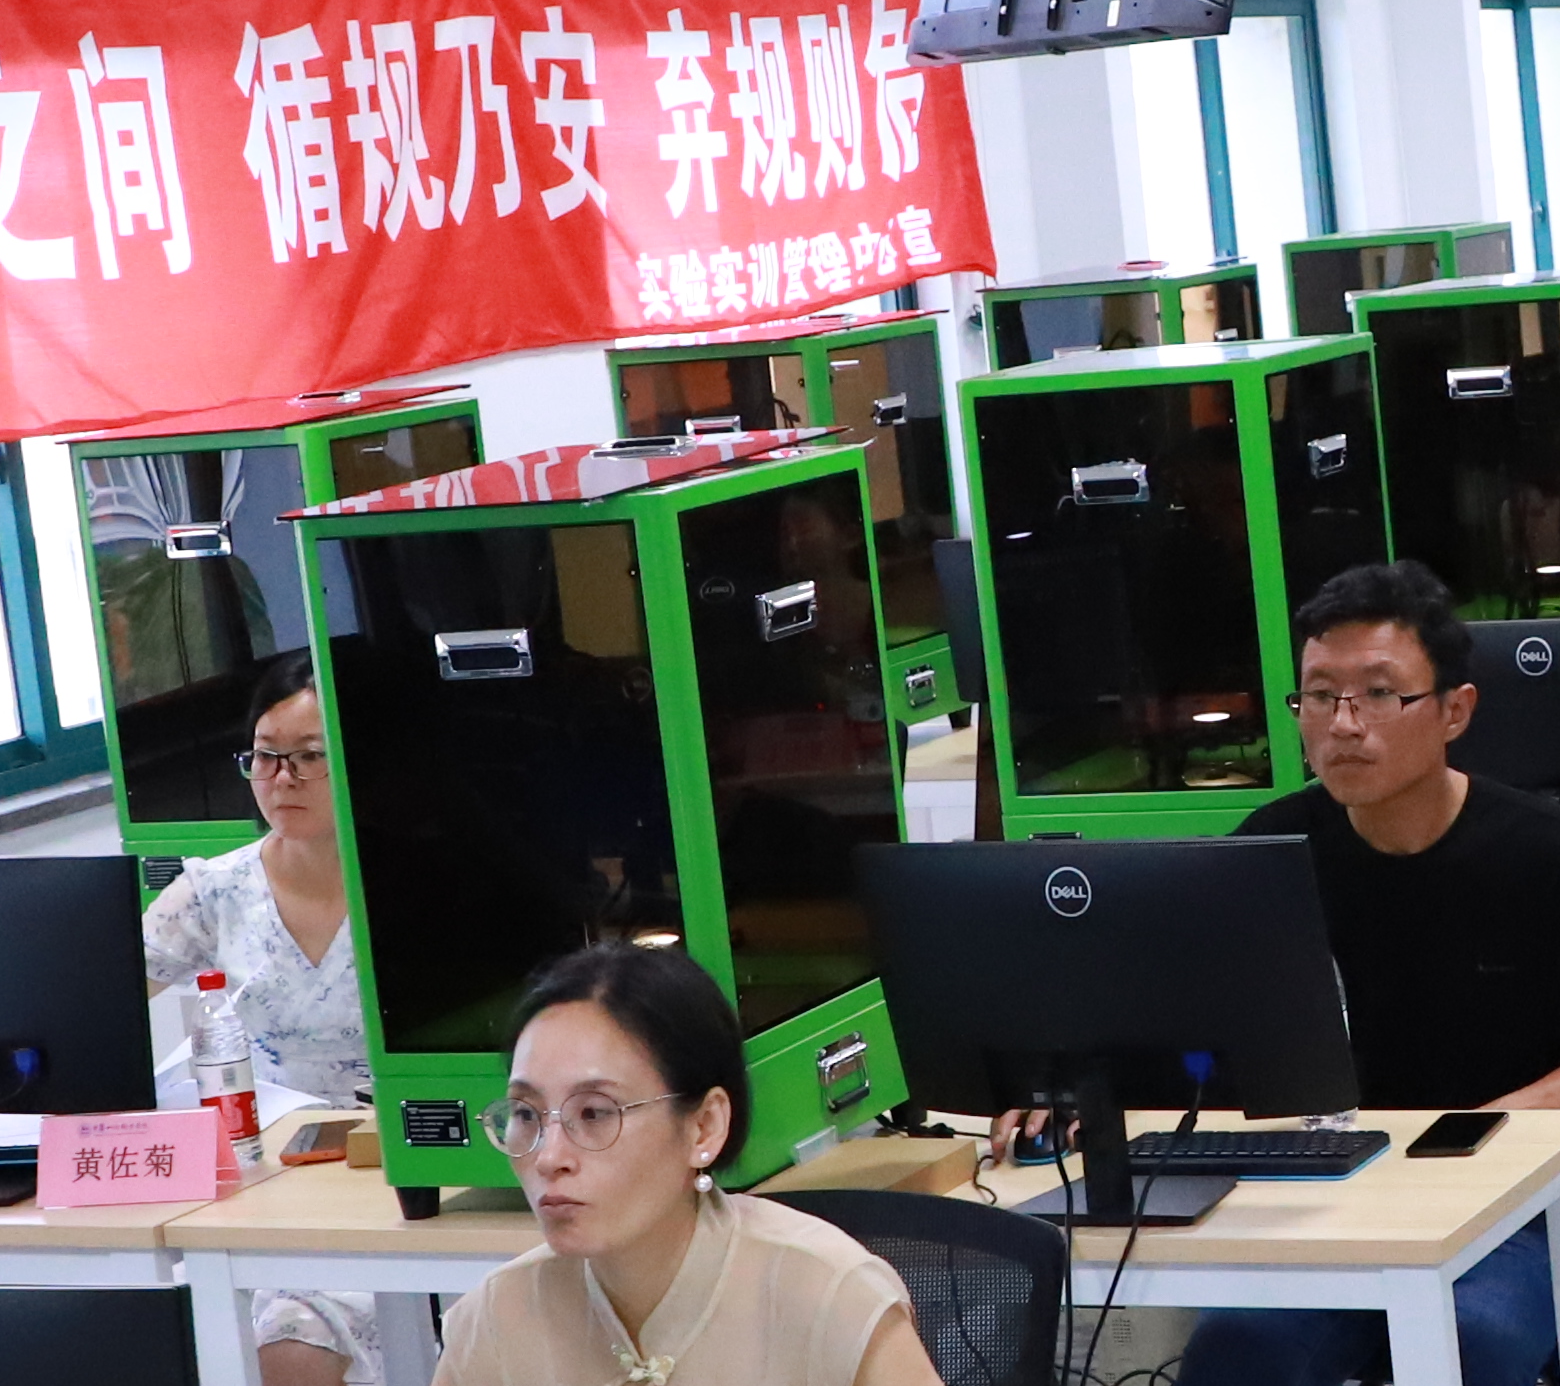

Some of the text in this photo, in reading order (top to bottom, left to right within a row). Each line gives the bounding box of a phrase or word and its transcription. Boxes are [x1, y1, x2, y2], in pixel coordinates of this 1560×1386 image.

[233, 5, 608, 263] 循规乃安
[1521, 652, 1549, 662] DELL
[1051, 886, 1087, 899] DELL
[71, 1143, 176, 1184] 黄佐菊
